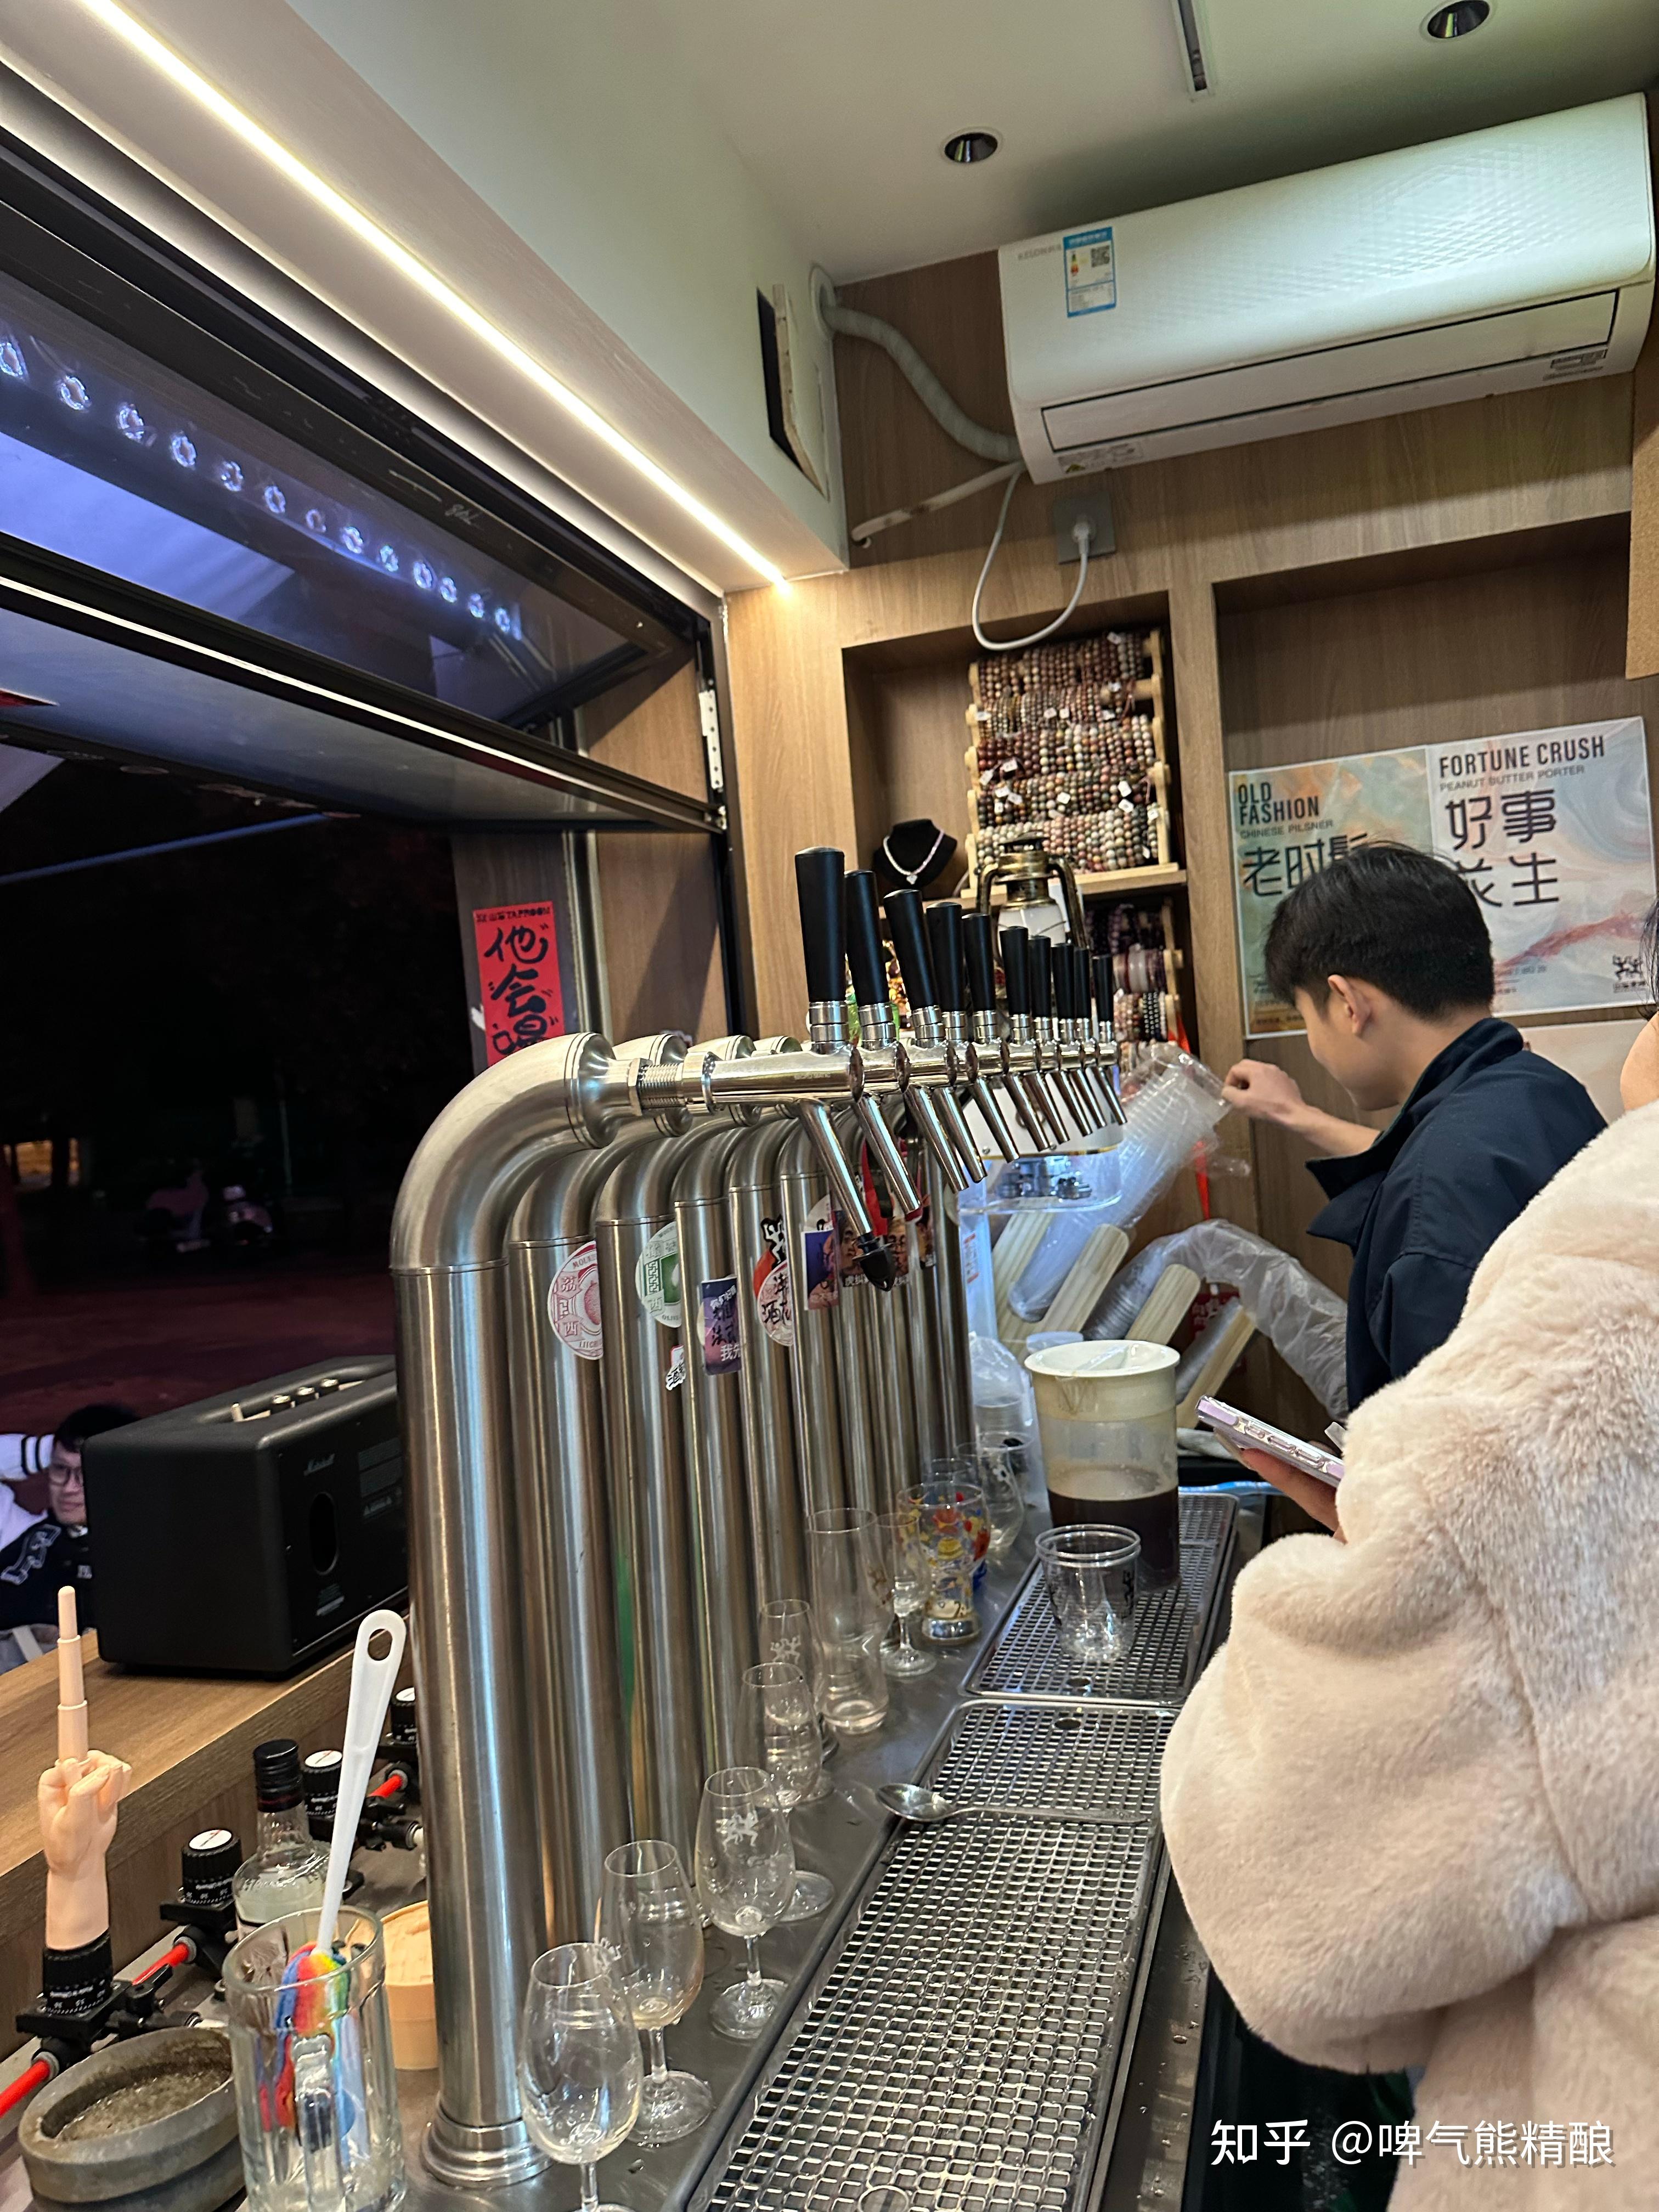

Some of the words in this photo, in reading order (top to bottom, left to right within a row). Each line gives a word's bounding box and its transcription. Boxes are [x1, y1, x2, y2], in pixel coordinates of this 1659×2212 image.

[1440, 745, 1530, 778] FORTUNE
[1537, 736, 1605, 765] CRUSH
[1440, 777, 1485, 792] PEANUT
[1488, 770, 1534, 786] BUTTER
[1537, 764, 1585, 778] PORTER
[1238, 782, 1272, 804] OLD
[1240, 795, 1319, 825] FASHION
[1445, 789, 1556, 850] 好事
[1240, 825, 1284, 839] CHINESE
[1288, 819, 1333, 833] PILSNER
